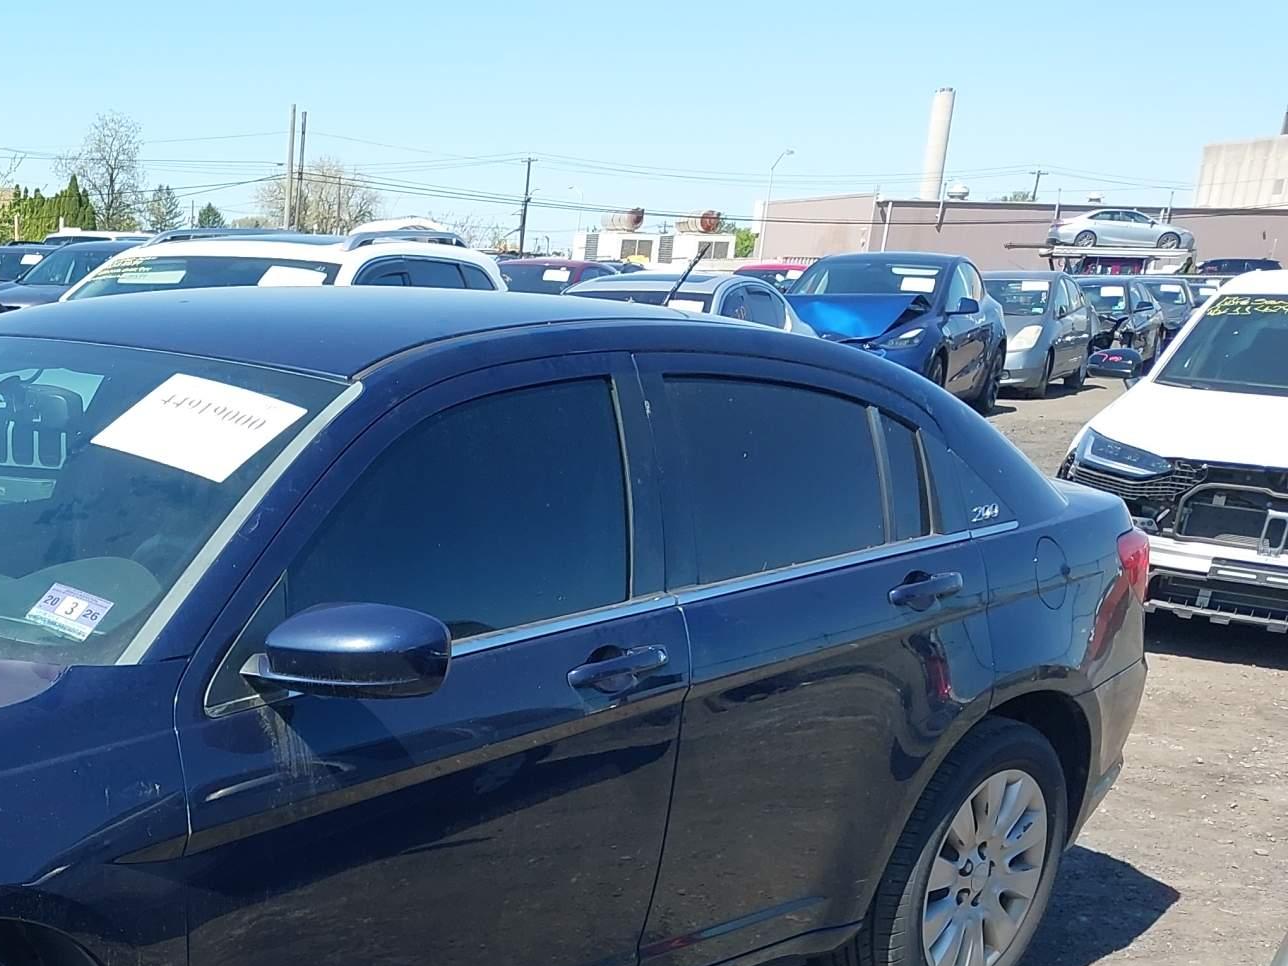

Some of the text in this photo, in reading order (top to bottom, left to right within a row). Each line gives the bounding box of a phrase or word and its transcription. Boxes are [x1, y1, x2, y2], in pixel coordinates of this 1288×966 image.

[160, 393, 267, 431] 44919000
[971, 502, 1000, 523] 200
[43, 594, 61, 607] 20
[64, 601, 79, 616] 3
[82, 609, 101, 622] 26
